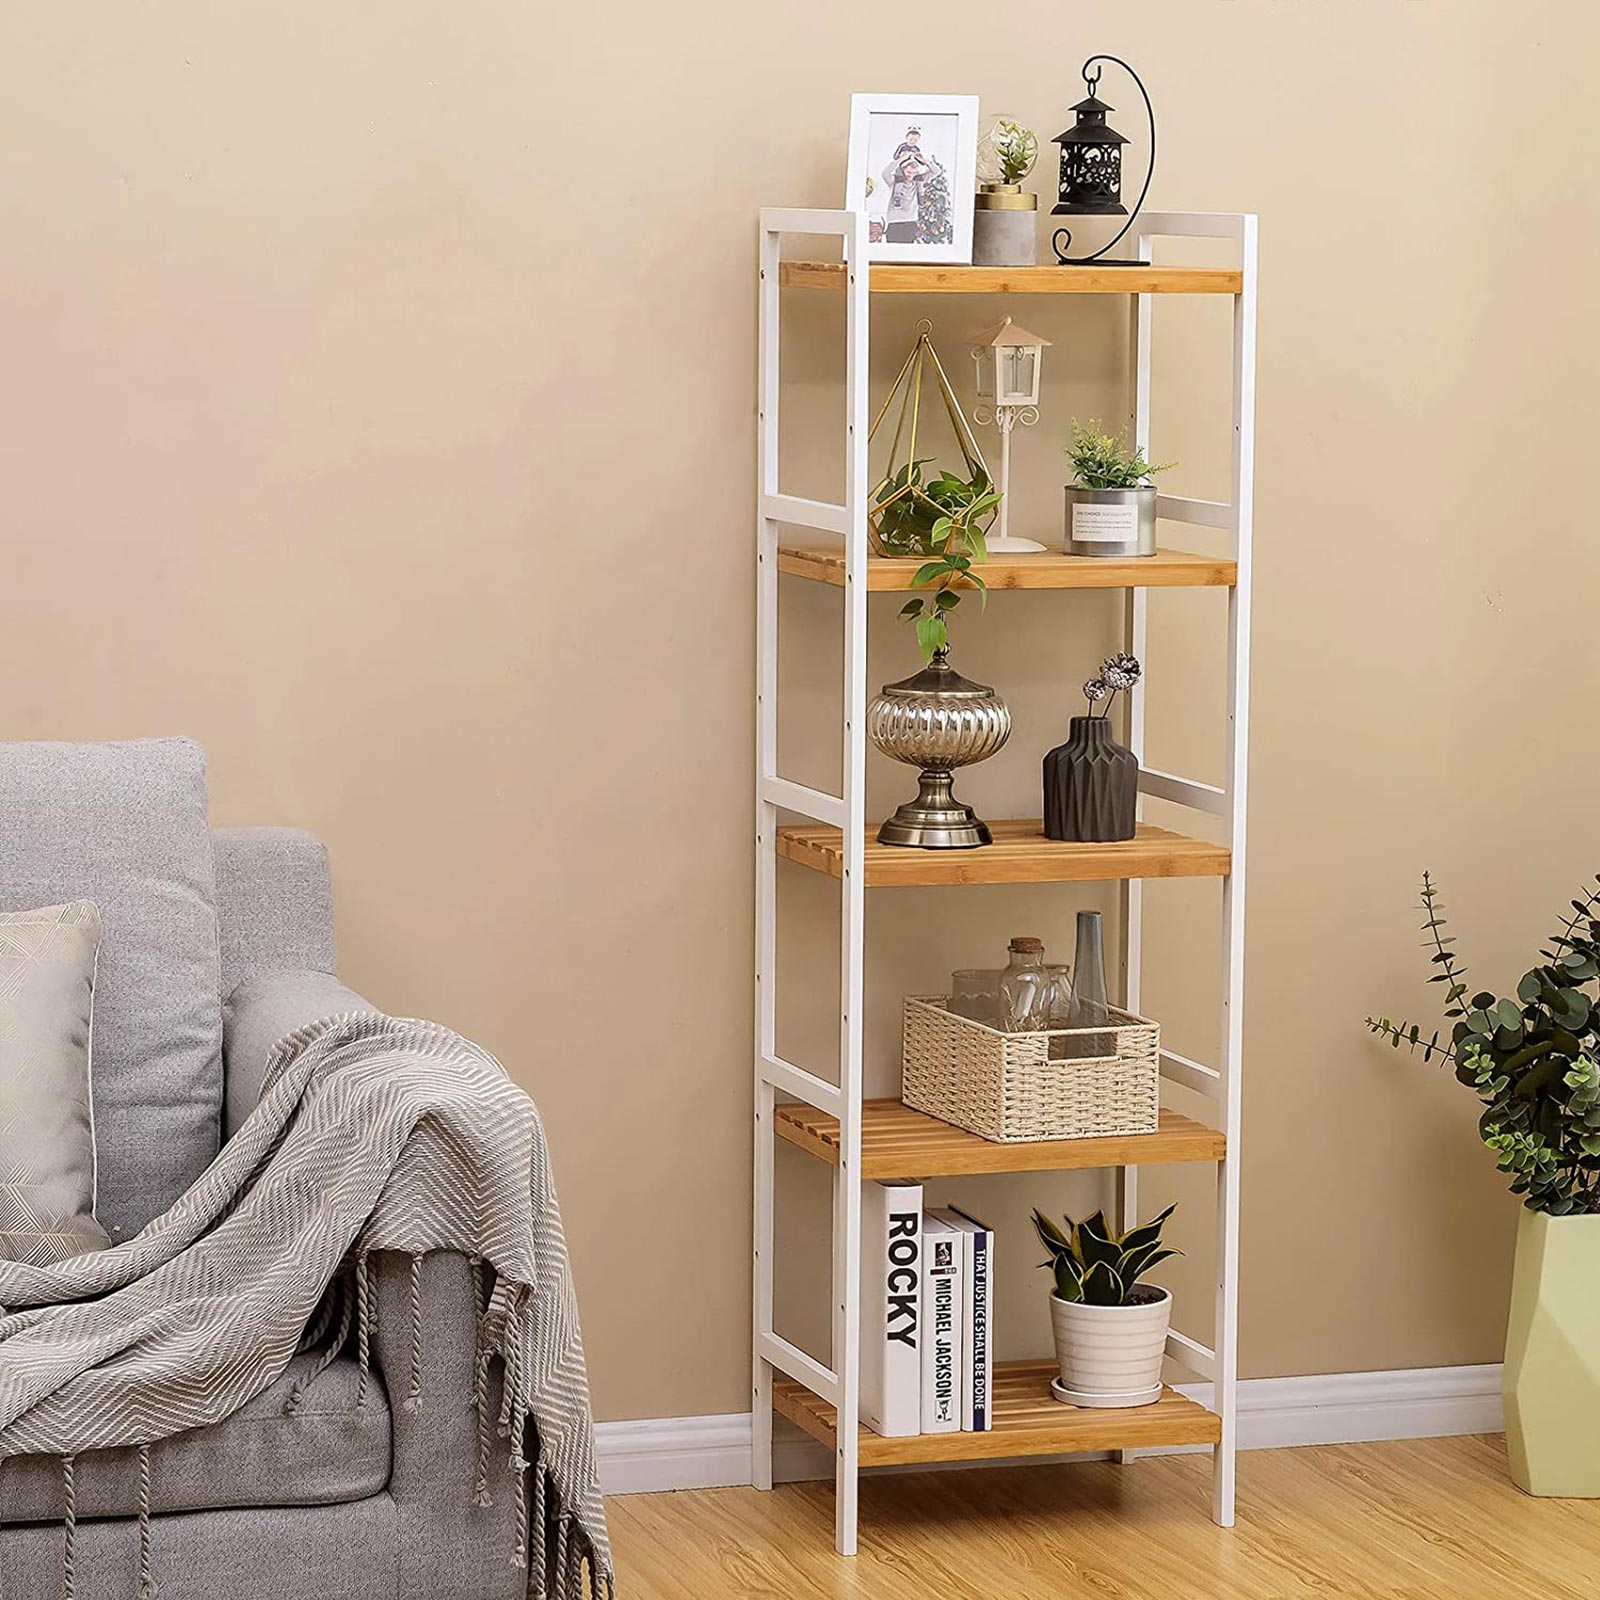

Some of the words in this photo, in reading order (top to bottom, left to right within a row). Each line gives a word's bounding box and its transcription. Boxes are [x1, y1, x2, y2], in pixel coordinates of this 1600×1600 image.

[887, 1212, 919, 1350] ROCKY
[975, 1249, 986, 1278] THAT
[935, 1278, 952, 1336] MICHAEL
[935, 1339, 952, 1399] JACKSON
[974, 1362, 985, 1377] BE
[974, 1378, 985, 1410] DONE
